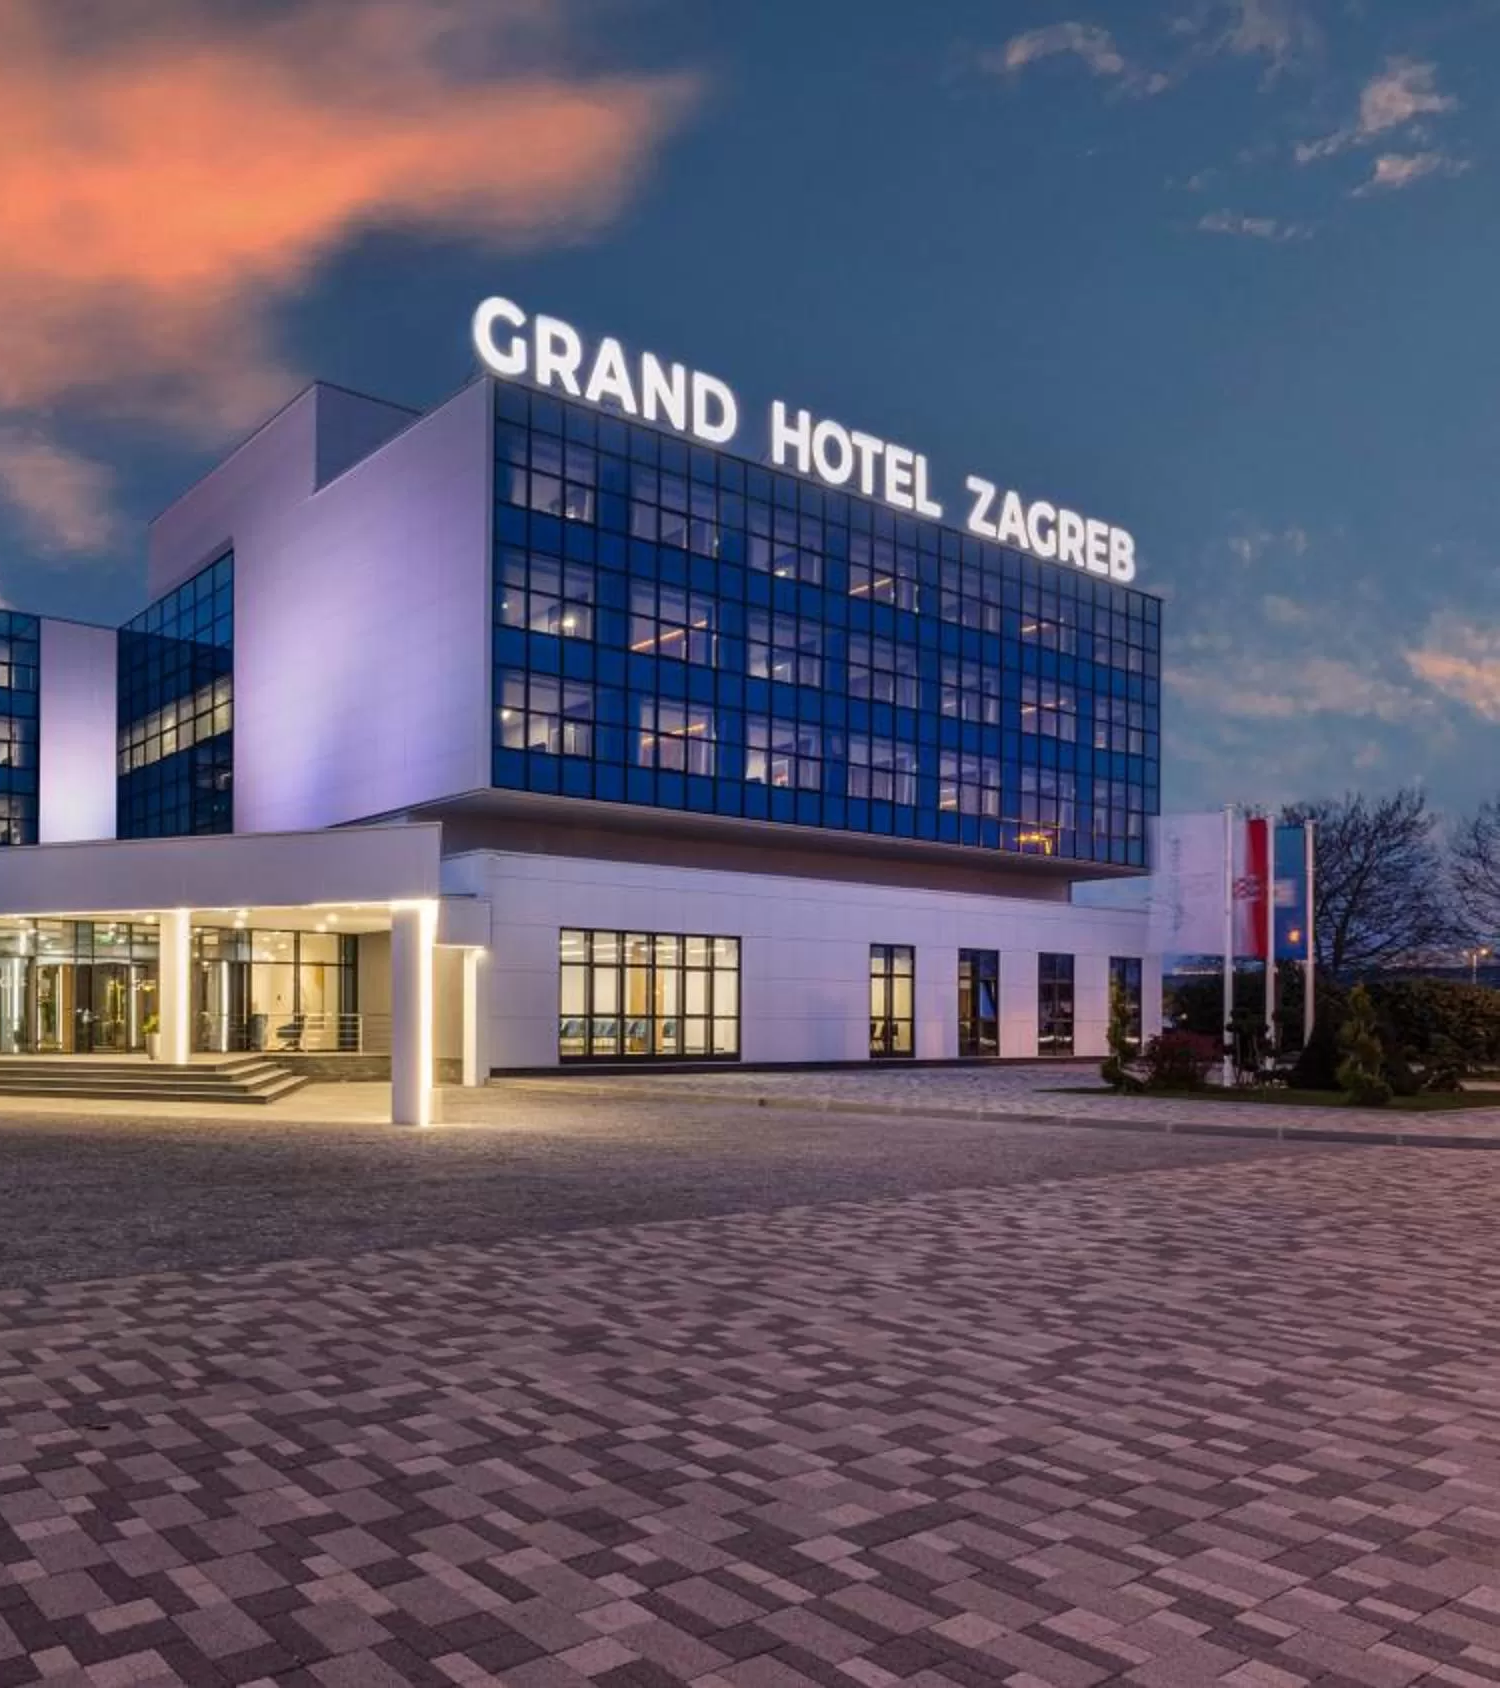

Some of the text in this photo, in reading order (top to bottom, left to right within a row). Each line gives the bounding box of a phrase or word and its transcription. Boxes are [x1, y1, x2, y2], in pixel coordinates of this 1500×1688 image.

[472, 295, 1137, 583] GRAND HOTEL ZAGREB
